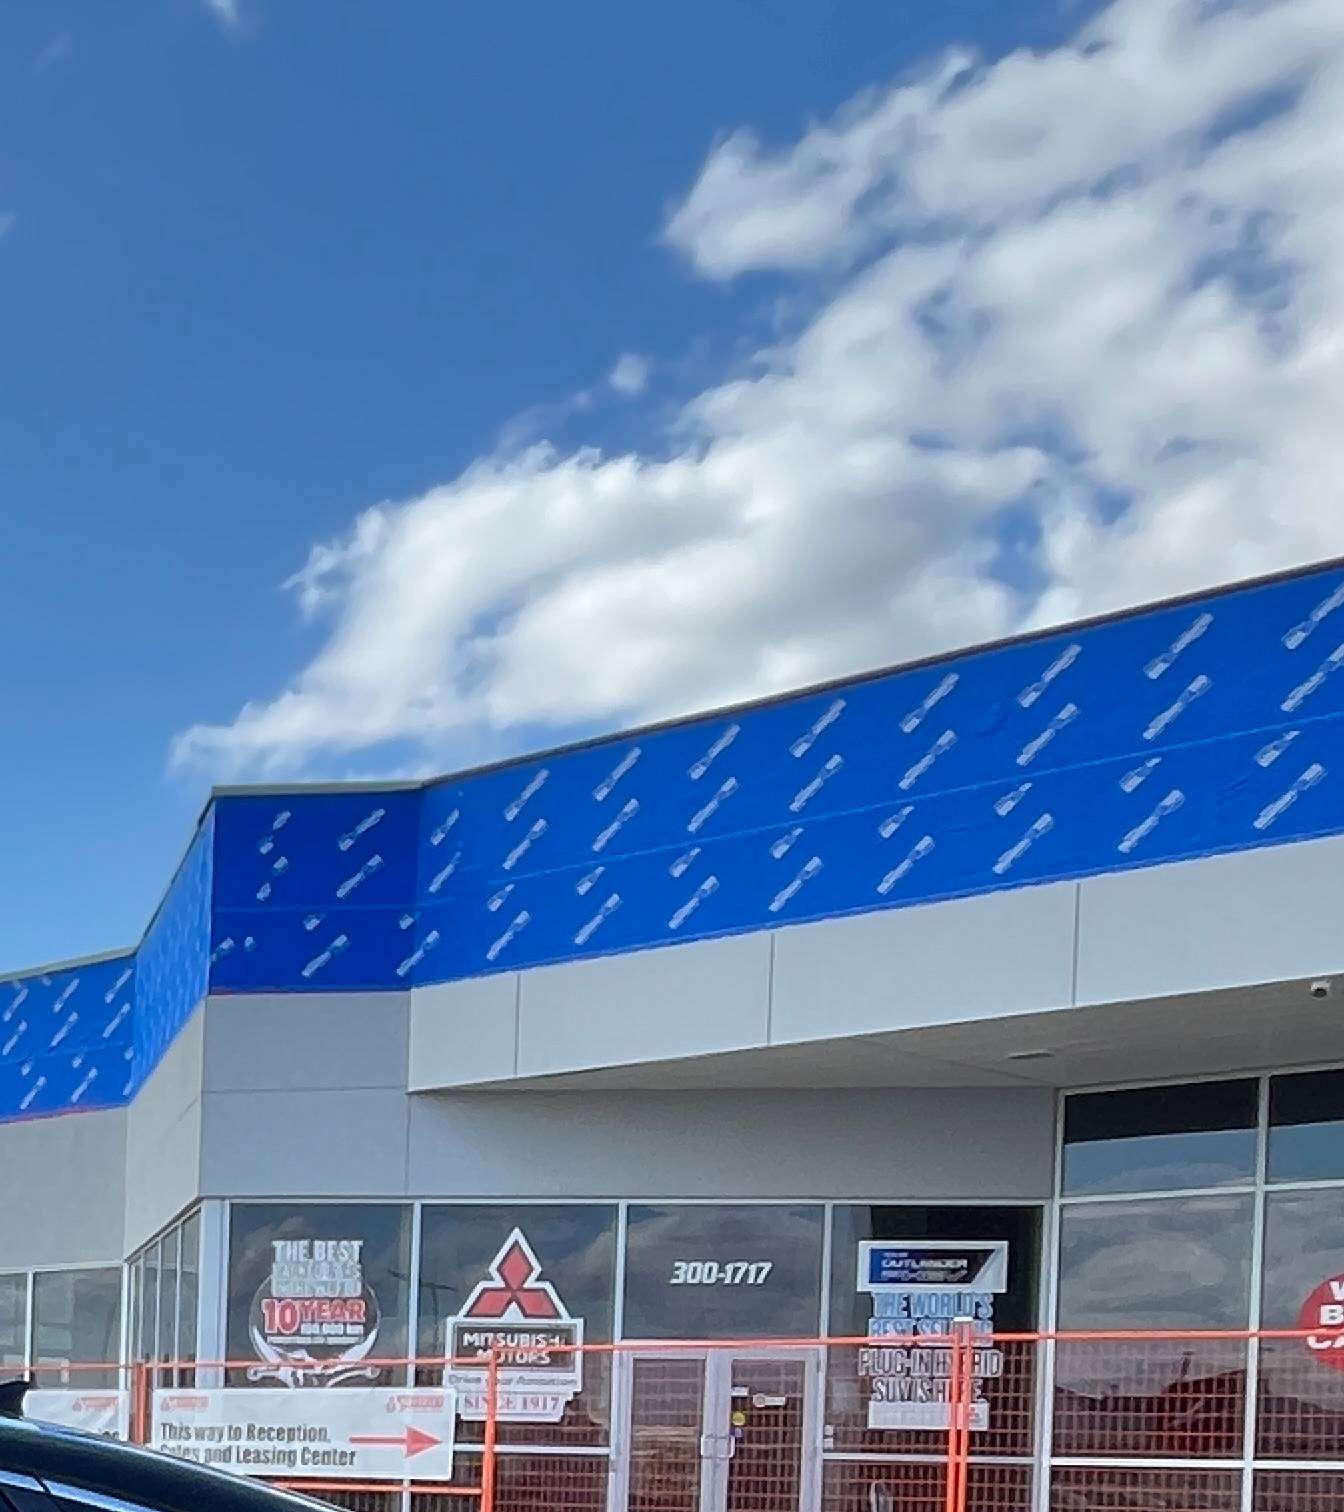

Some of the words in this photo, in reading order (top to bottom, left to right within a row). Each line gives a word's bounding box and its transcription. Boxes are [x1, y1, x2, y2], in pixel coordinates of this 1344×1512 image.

[272, 1240, 311, 1261] THE
[314, 1240, 363, 1262] BEST
[670, 1261, 772, 1284] 300-1717
[262, 1299, 299, 1334] 10
[300, 1300, 366, 1322] YEAR
[858, 1349, 932, 1376] PLUG-IN
[933, 1377, 984, 1402] HE
[465, 1394, 517, 1410] SINE
[161, 1423, 193, 1441] This
[194, 1426, 226, 1443] way
[228, 1424, 243, 1441] to
[204, 1446, 232, 1463] and
[236, 1446, 297, 1468] Leasing
[300, 1446, 357, 1466] Center
